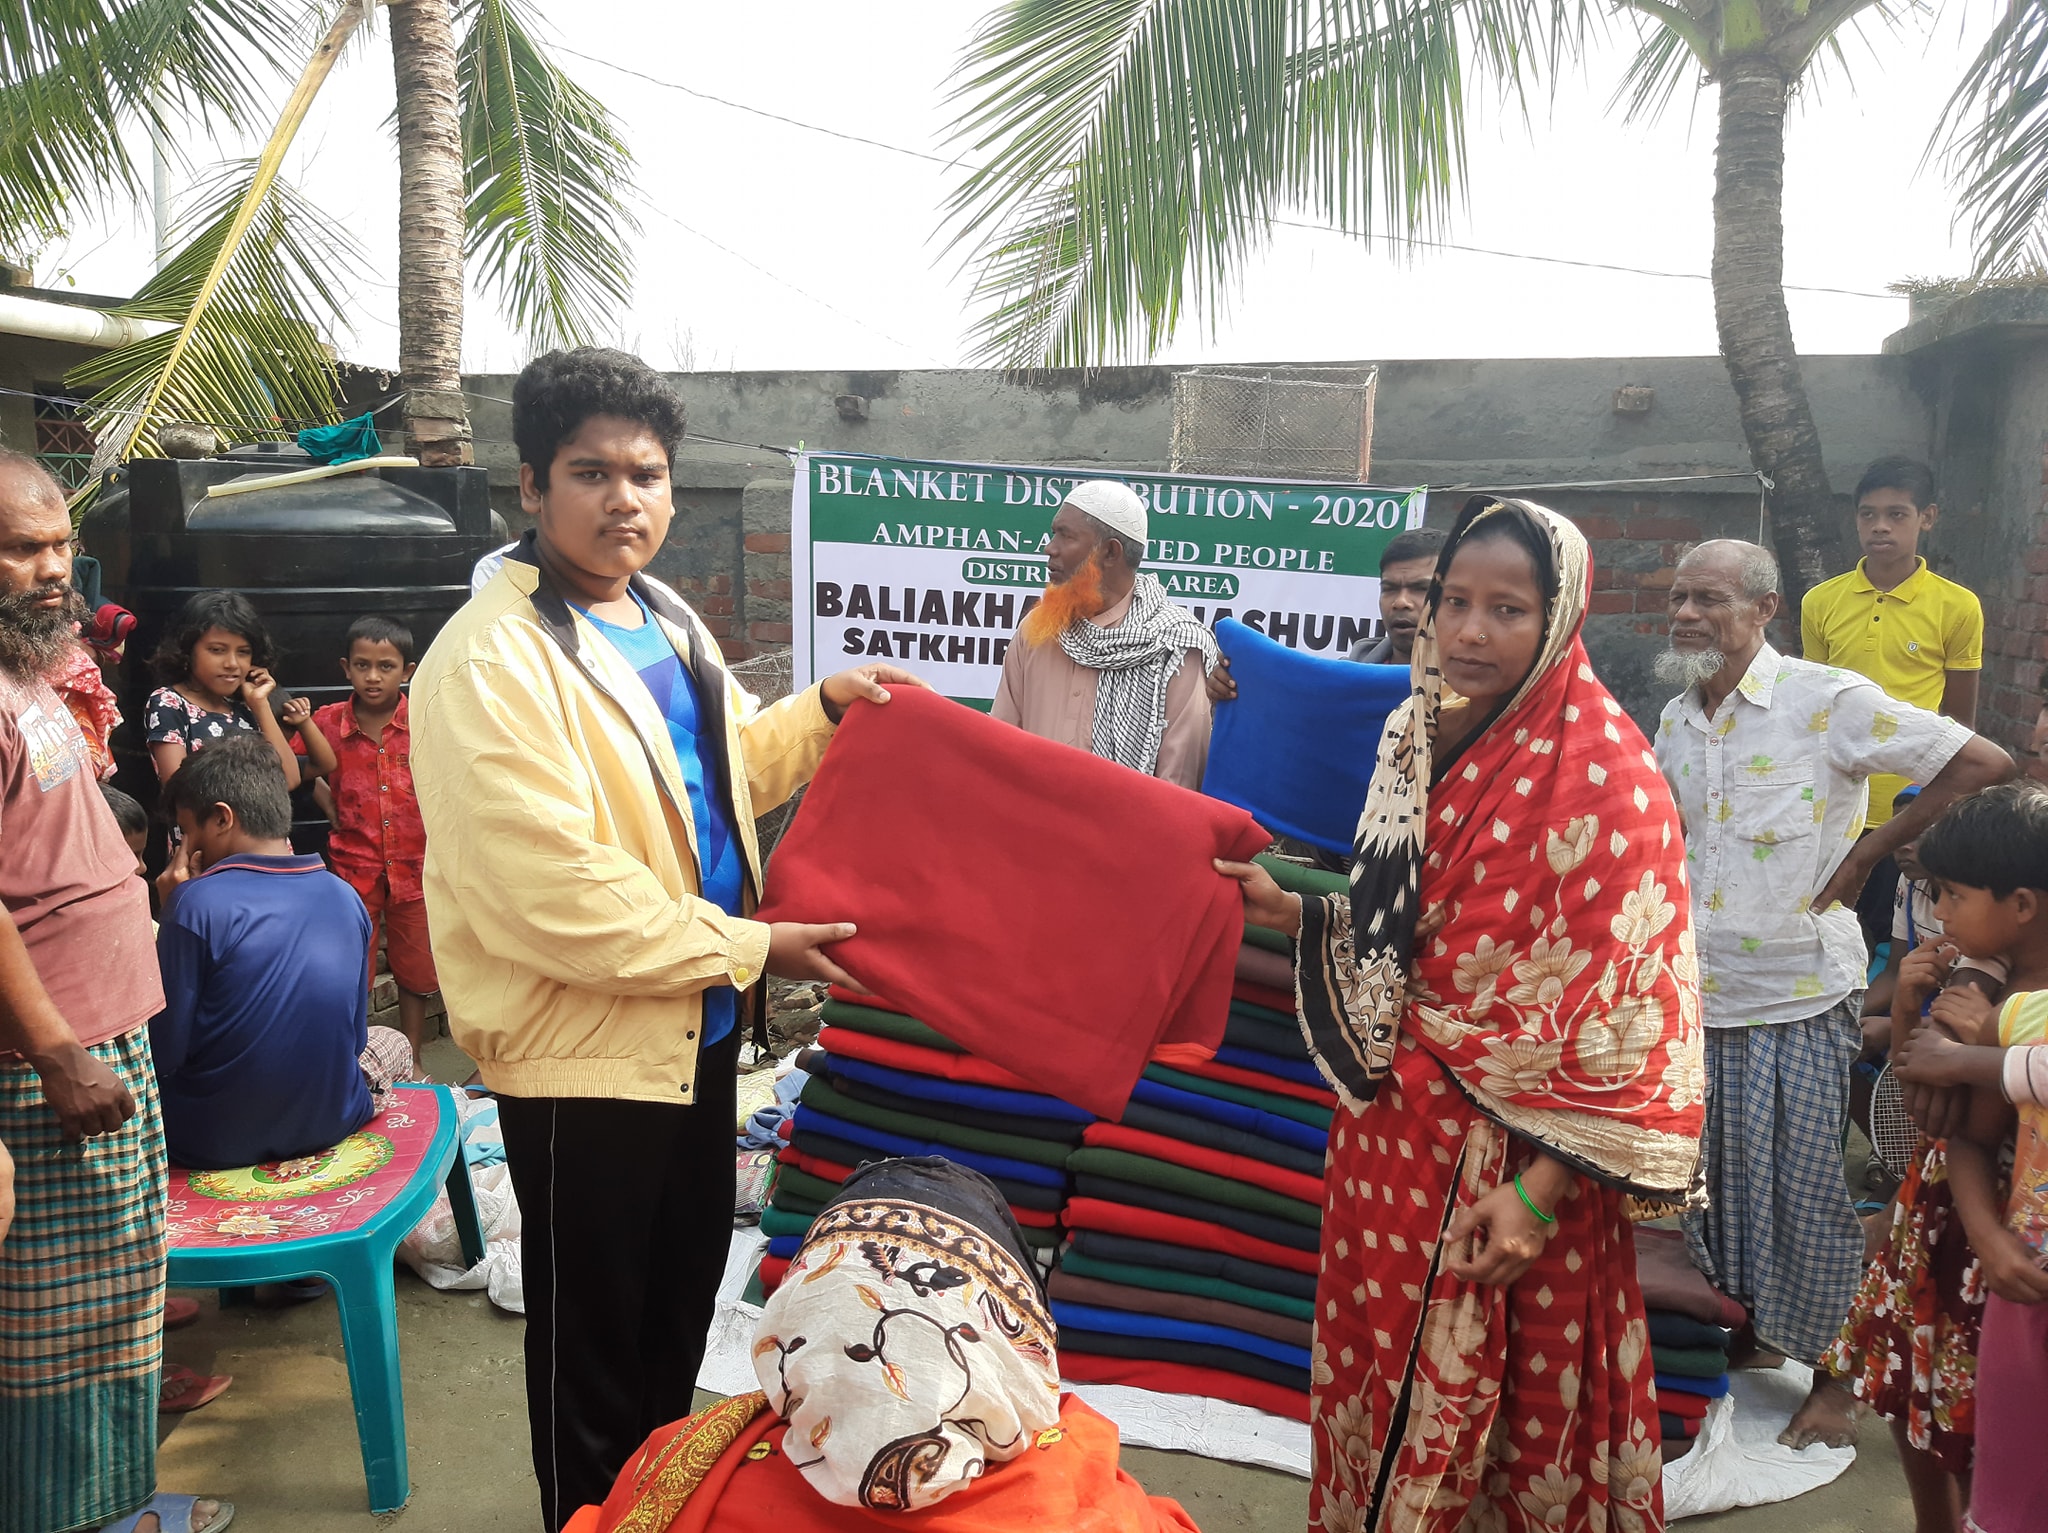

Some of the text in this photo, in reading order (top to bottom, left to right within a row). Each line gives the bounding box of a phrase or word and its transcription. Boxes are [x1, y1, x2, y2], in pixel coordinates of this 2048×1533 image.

[817, 463, 993, 504] BLANKET
[1003, 473, 1275, 521] DISTBUTION
[1310, 495, 1401, 530] 2020
[871, 522, 1335, 572] AMPHAN-ATED PEOPLE
[1165, 575, 1236, 595] AREA
